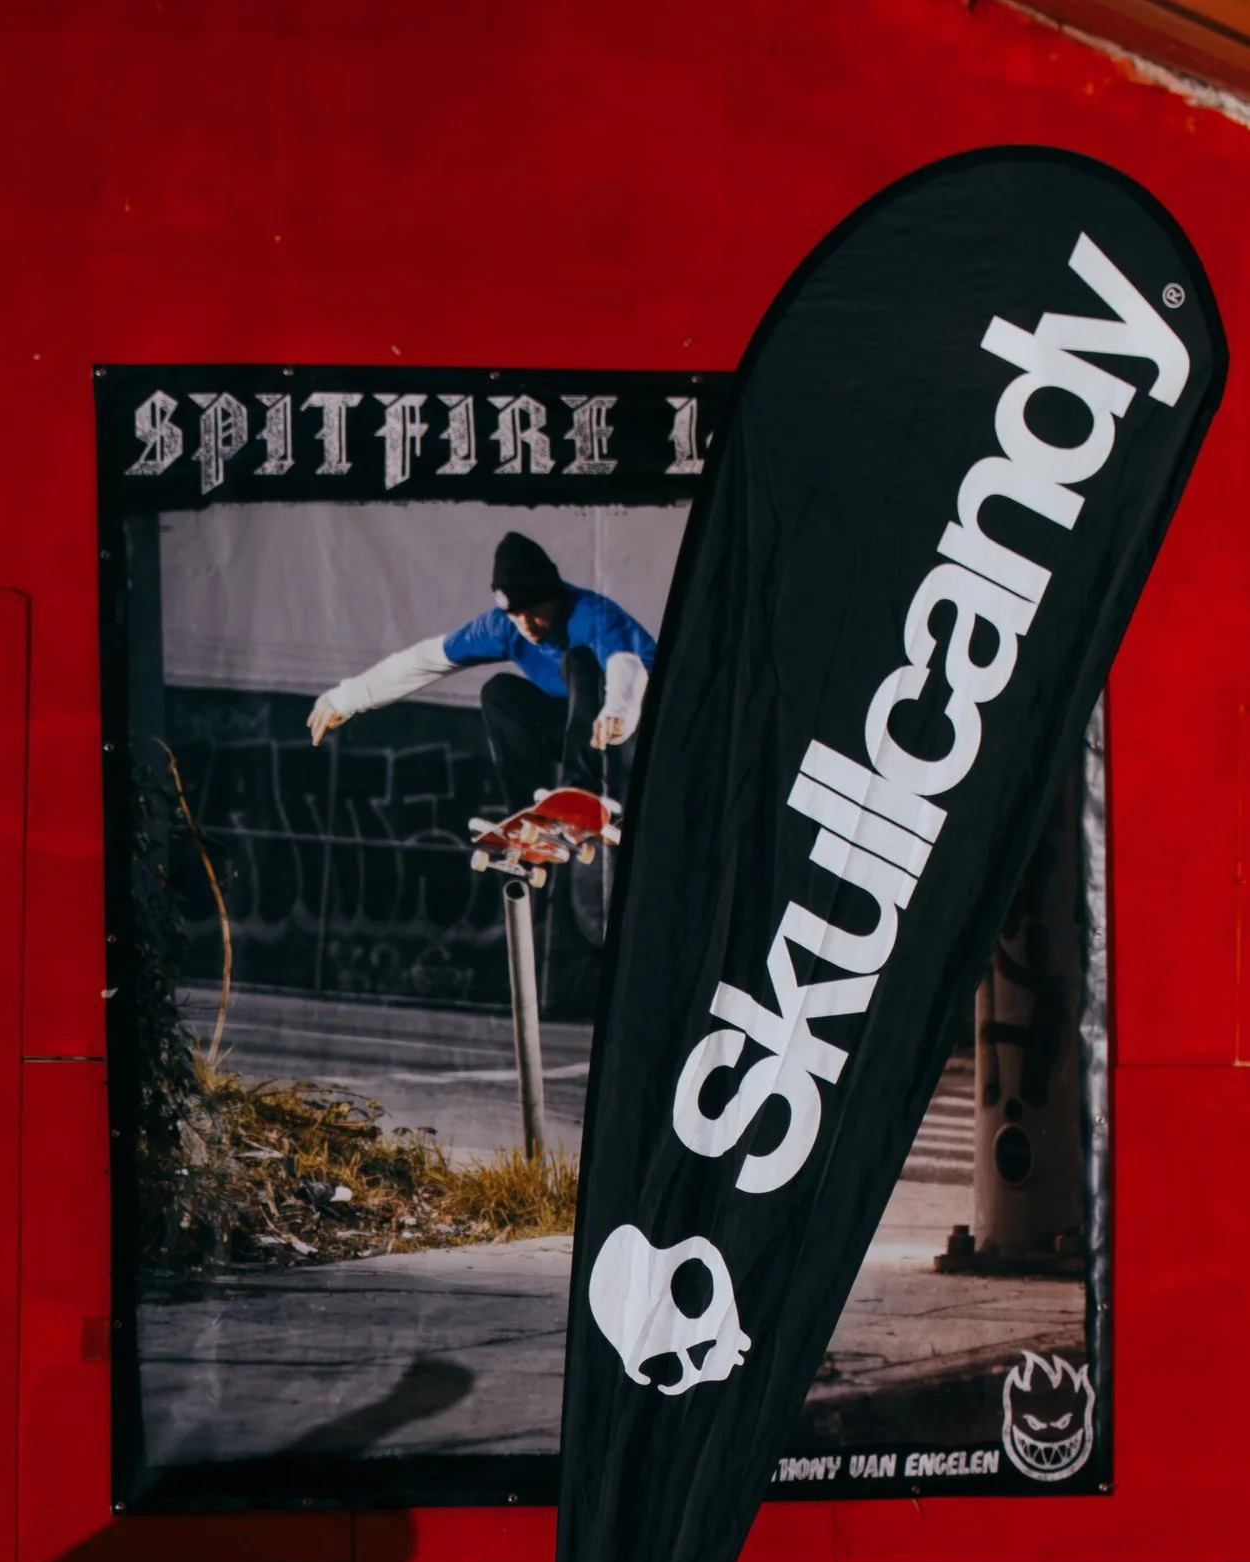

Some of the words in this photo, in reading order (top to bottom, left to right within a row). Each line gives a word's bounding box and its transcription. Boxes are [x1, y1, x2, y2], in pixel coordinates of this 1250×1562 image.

[123, 388, 619, 496] SPITFIRE
[849, 1453, 898, 1478] VAN
[904, 1448, 1000, 1477] ENGELEN
